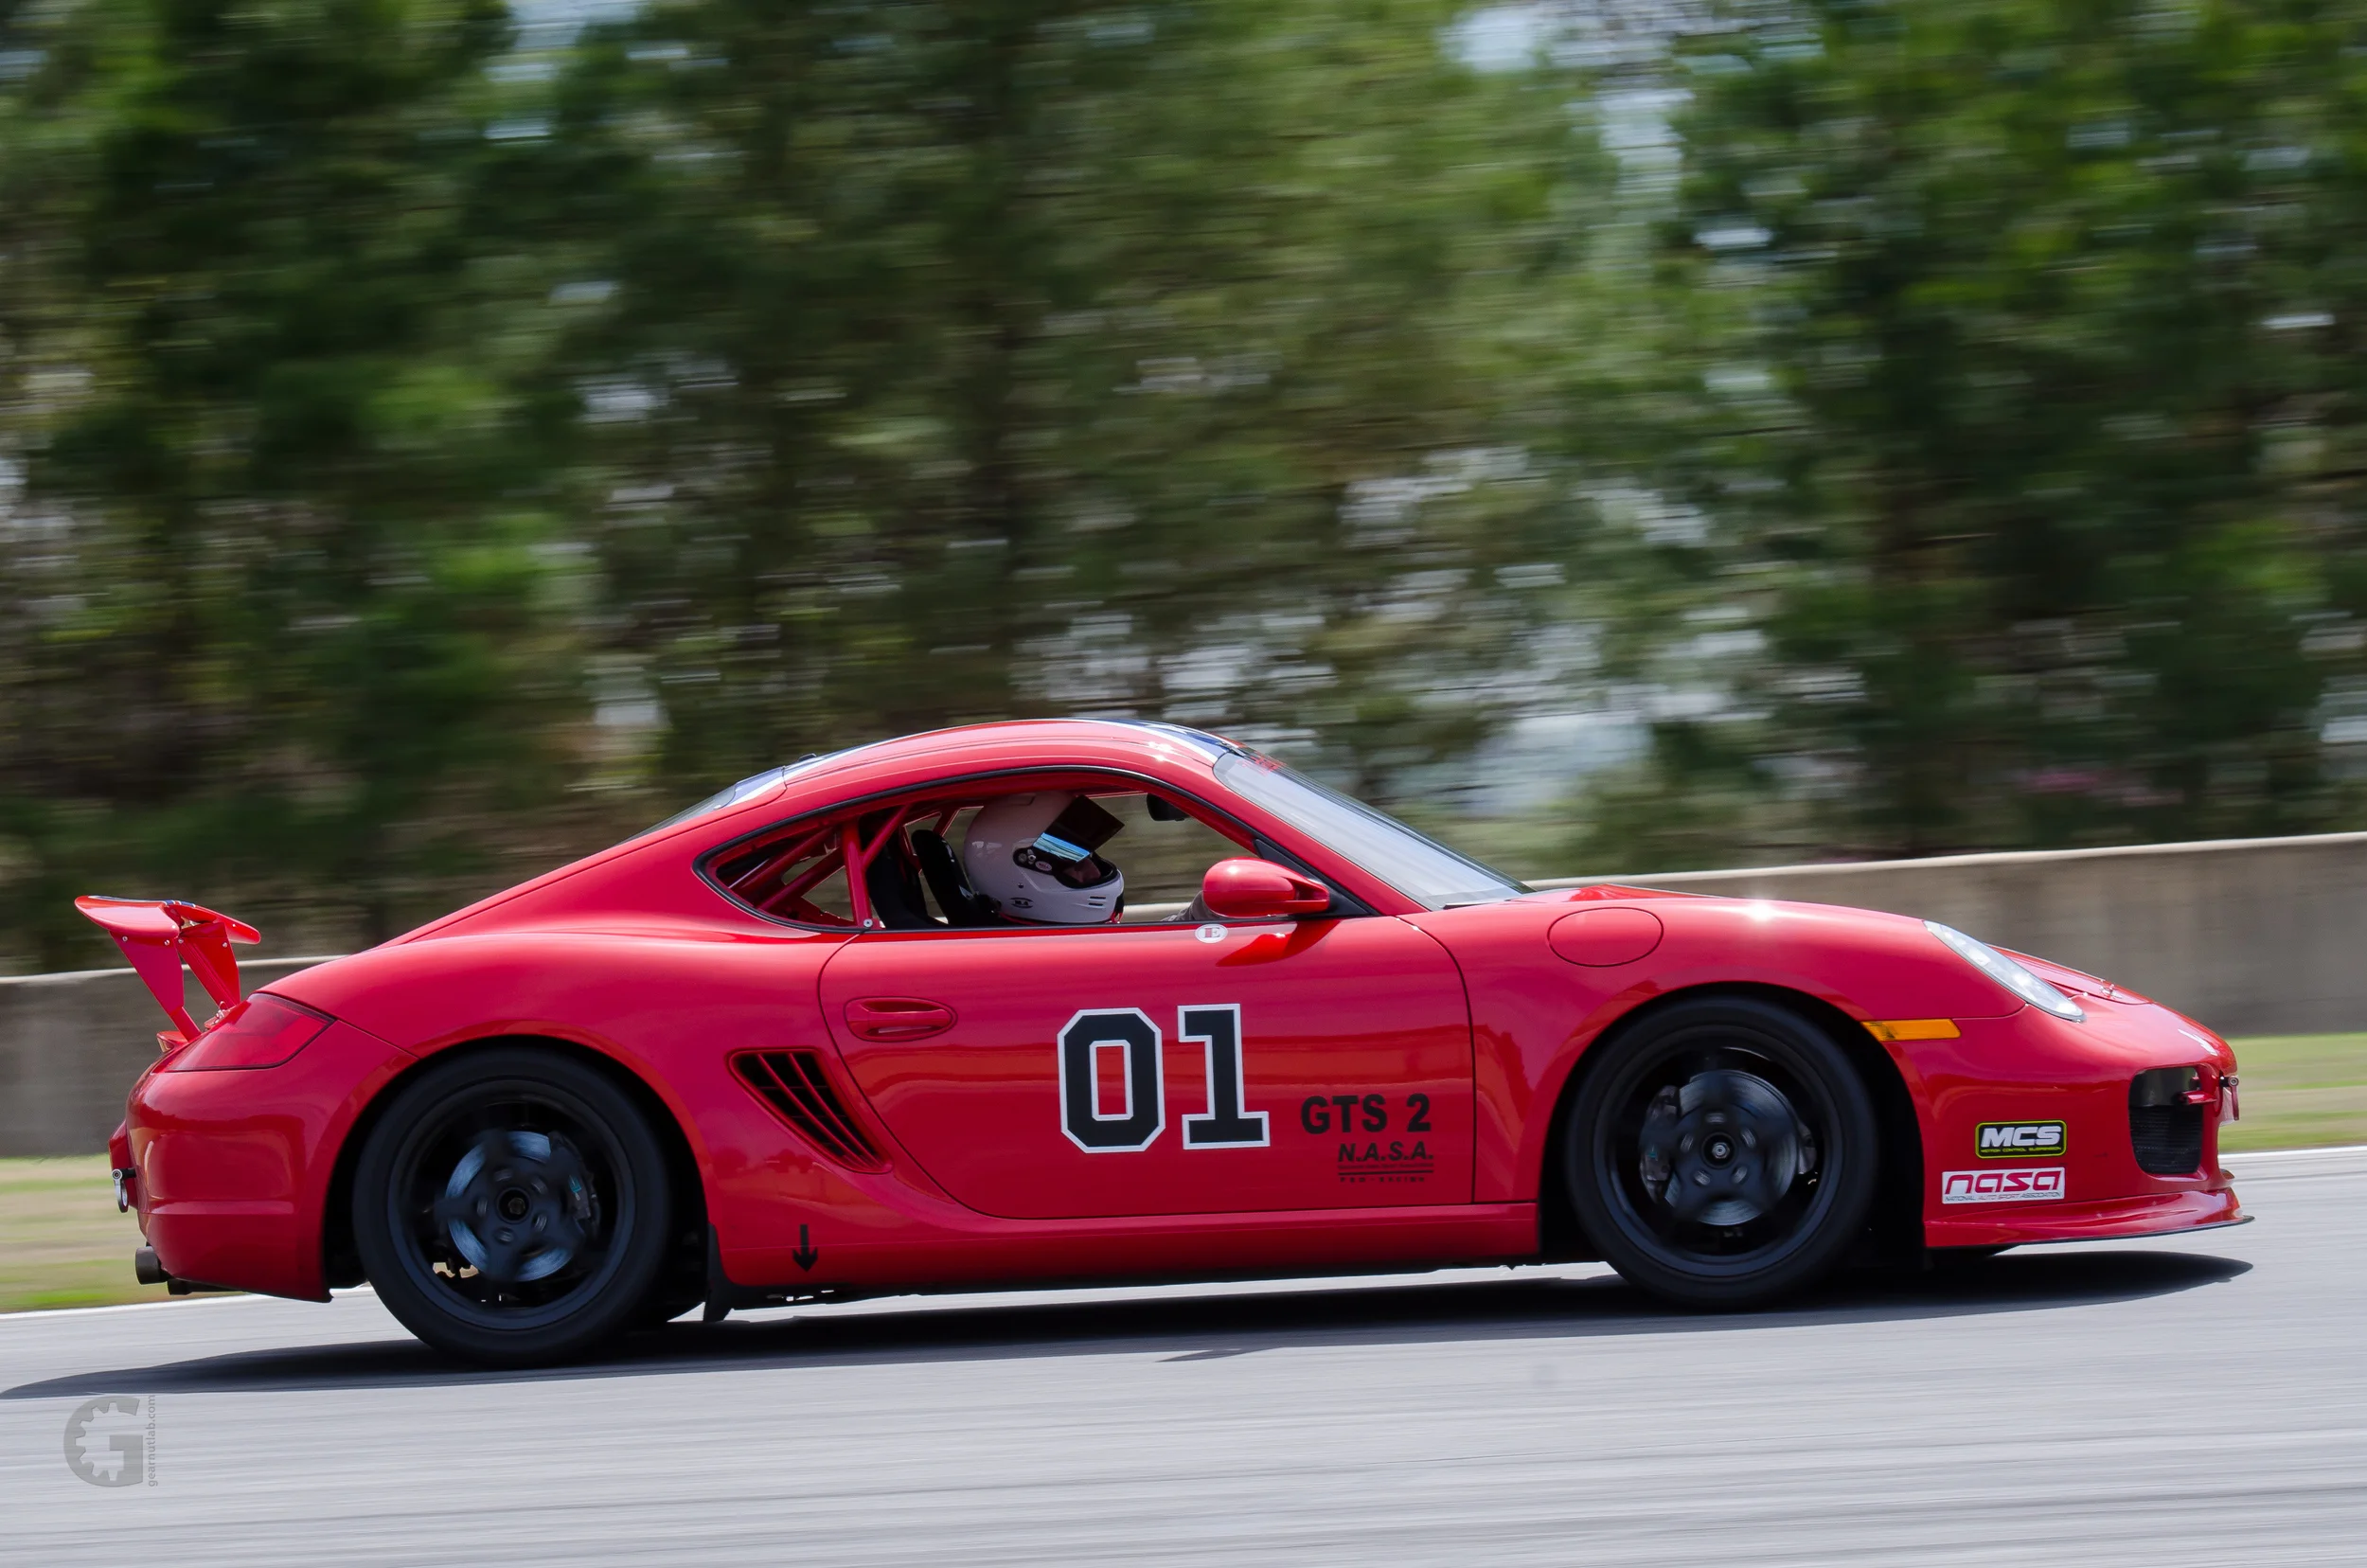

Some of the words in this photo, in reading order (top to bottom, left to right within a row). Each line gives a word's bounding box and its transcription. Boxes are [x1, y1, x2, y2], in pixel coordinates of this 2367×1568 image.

[1058, 1004, 1270, 1153] 01
[1301, 1094, 1388, 1134] GTS
[1406, 1093, 1432, 1132] 2
[1338, 1141, 1433, 1163] N.A.S.A.
[1981, 1126, 2061, 1148] MCS
